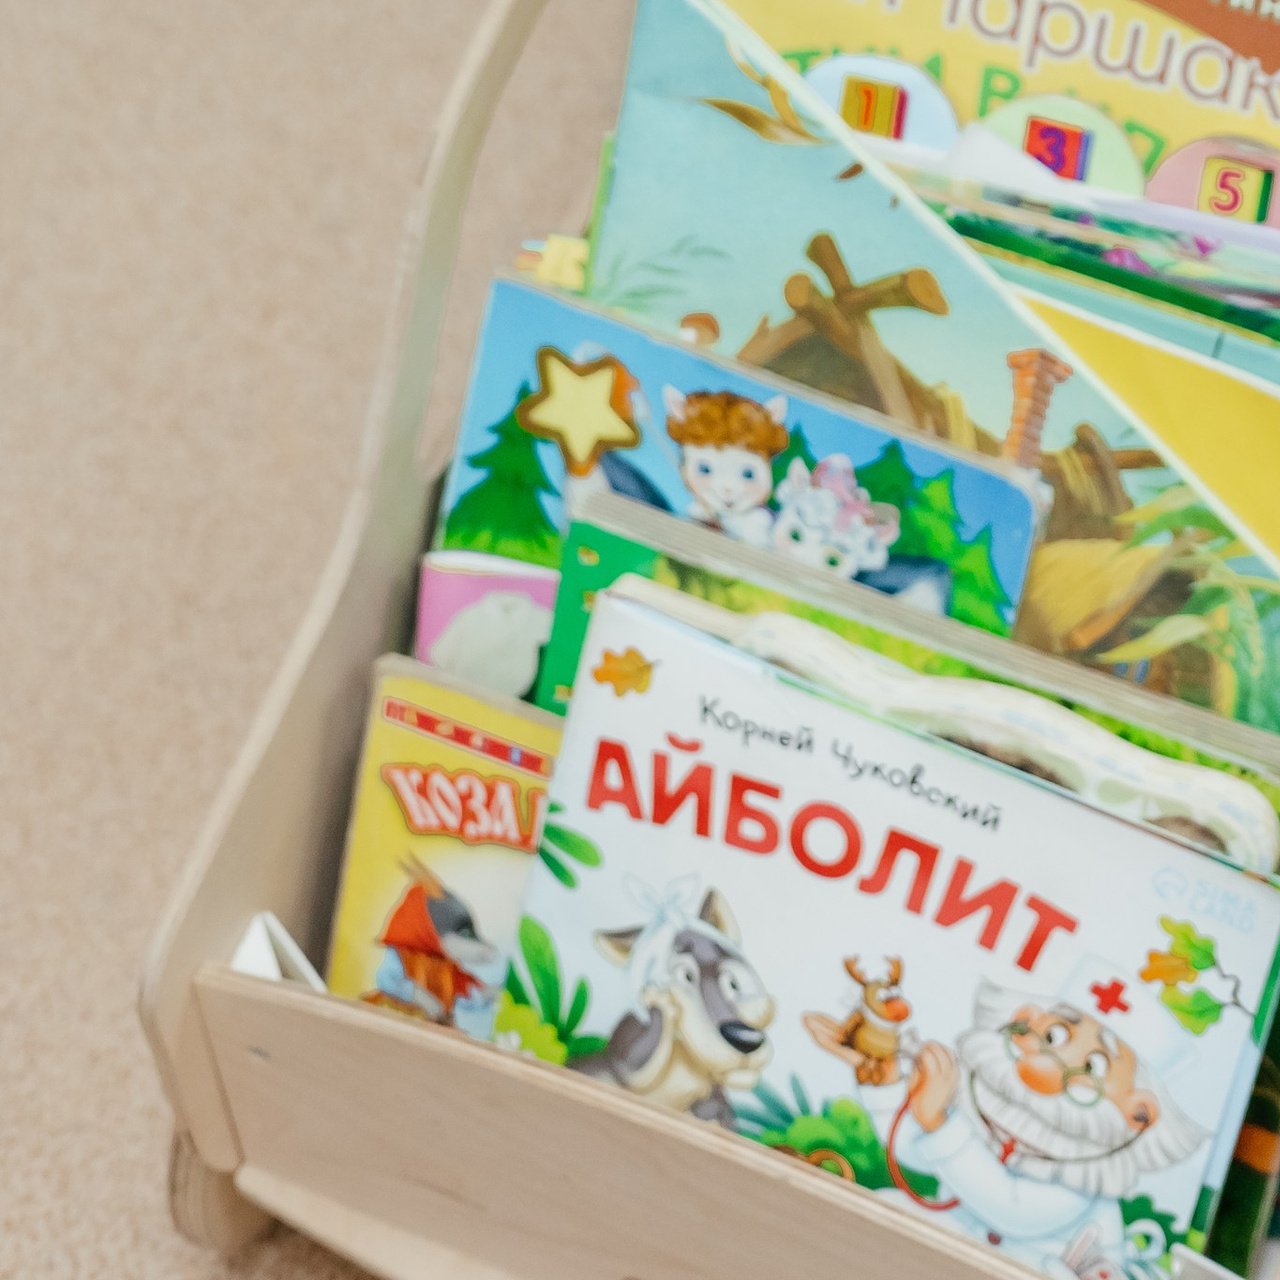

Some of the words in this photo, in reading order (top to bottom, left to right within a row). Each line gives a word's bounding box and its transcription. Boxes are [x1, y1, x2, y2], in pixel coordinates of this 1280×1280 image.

[857, 82, 878, 132] 1
[1025, 125, 1067, 174] 3
[1208, 168, 1246, 214] 5
[698, 694, 815, 754] Корней
[830, 736, 1004, 831] Чуковский
[585, 731, 1080, 973] АЙБОЛИТ
